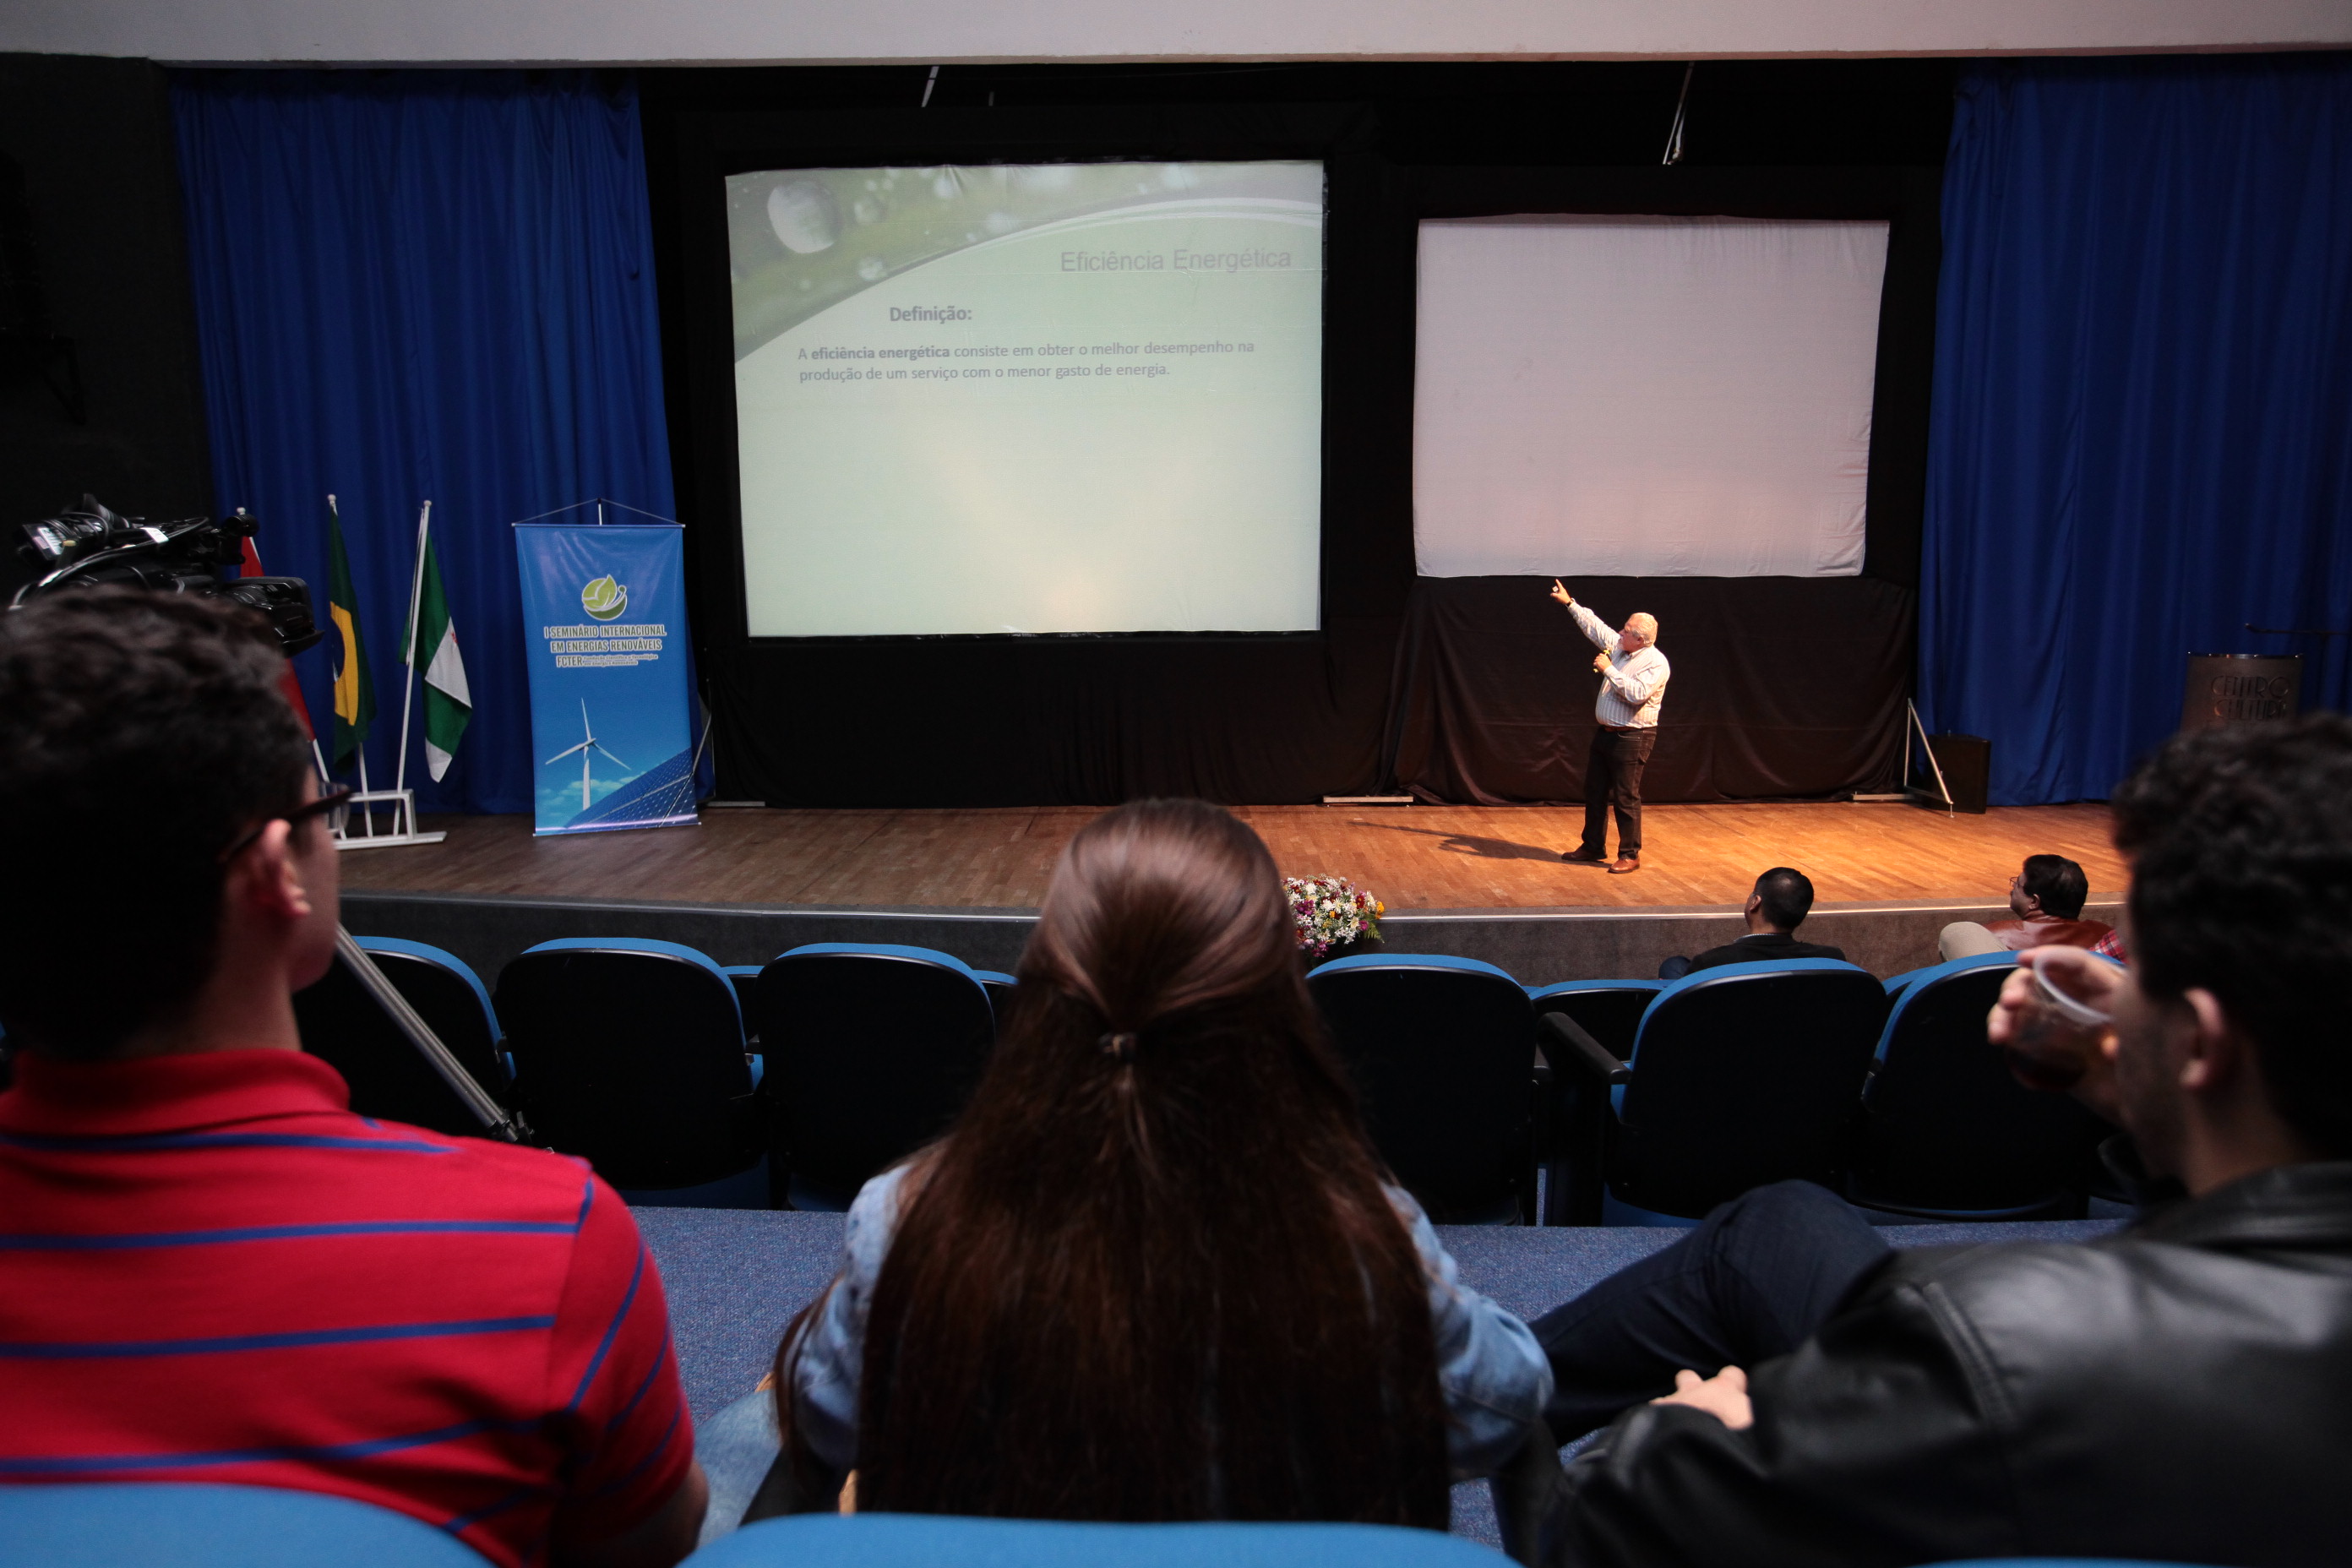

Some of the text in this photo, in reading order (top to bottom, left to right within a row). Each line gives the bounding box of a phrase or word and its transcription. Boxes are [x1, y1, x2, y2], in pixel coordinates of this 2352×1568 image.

[1060, 248, 1291, 274] Eficiência Energética
[889, 305, 972, 325] Definição:
[798, 340, 1255, 362] A eficiência energética consiste em obter o melhor desempenho na
[799, 363, 1170, 384] produção de um serviço com o menor gasto de energia.
[544, 624, 667, 638] I SEMINÁRIO INTERNACIONAL
[551, 638, 662, 652] EM ENERGIAS RENOVÁVEIS
[557, 656, 582, 667] FCTER
